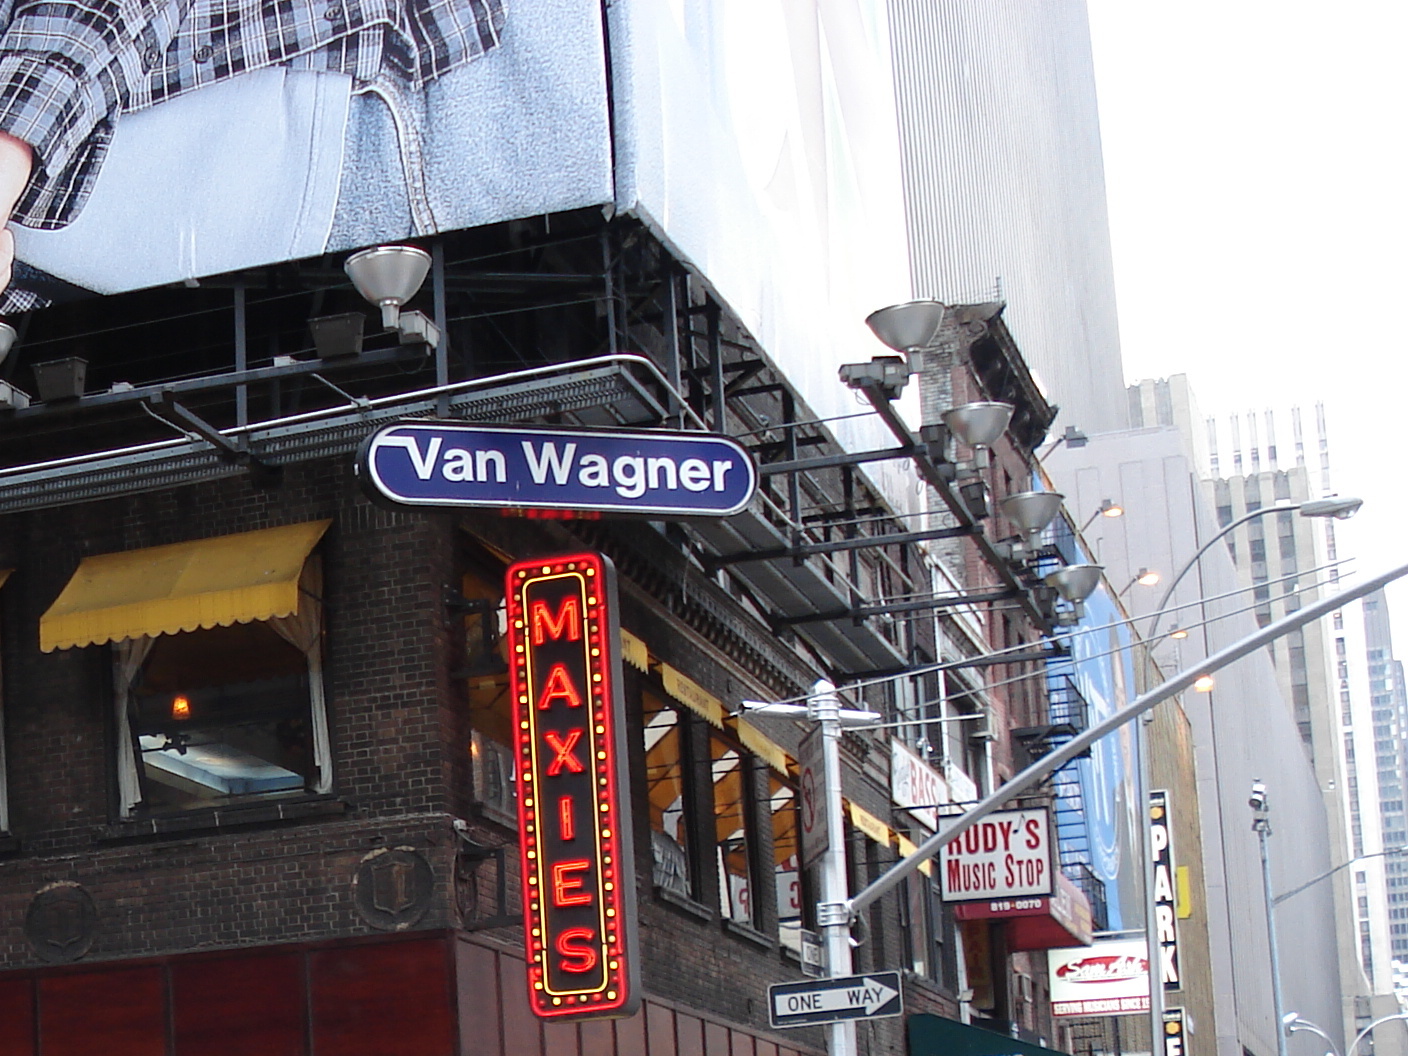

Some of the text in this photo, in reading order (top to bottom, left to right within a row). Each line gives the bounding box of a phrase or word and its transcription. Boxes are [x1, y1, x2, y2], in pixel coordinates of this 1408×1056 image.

[403, 435, 734, 499] Van Wagner
[1150, 824, 1178, 983] PARK
[787, 987, 884, 1012] ONE WAY
